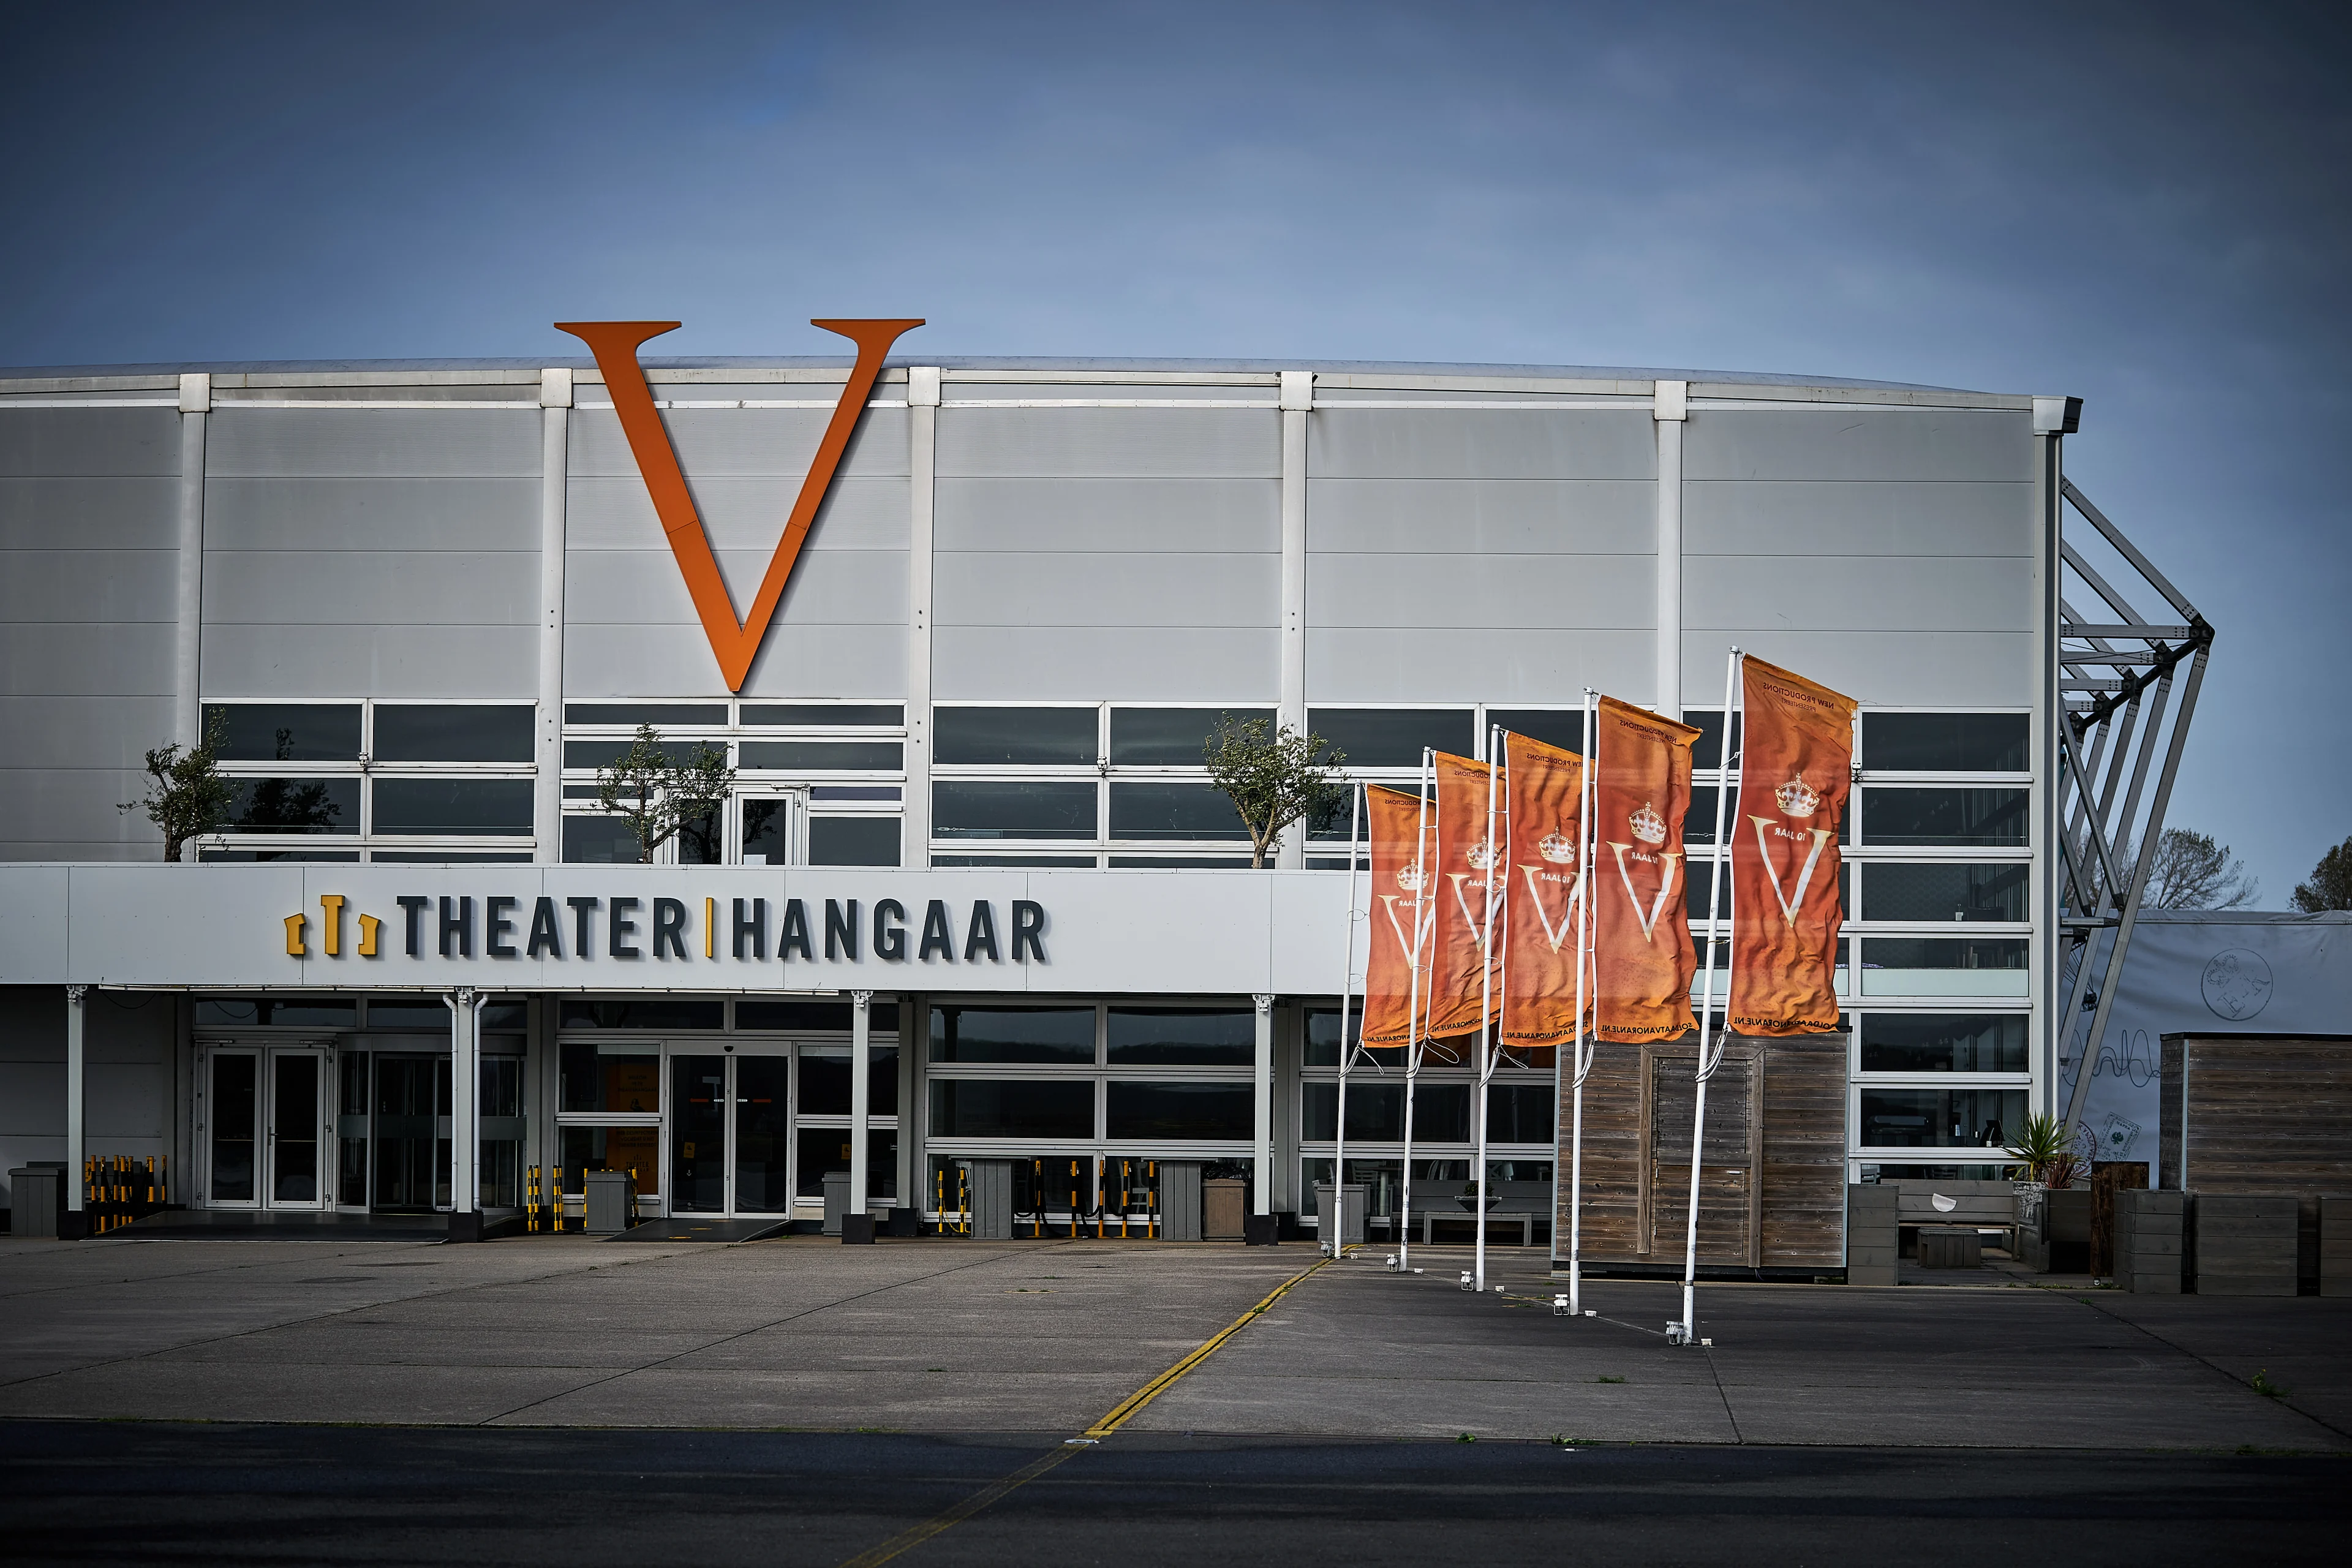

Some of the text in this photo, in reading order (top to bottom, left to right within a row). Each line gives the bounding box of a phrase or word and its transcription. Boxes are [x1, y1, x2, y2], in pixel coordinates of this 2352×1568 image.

[554, 318, 925, 692] V
[396, 895, 1046, 960] THEATER HANGAAR
